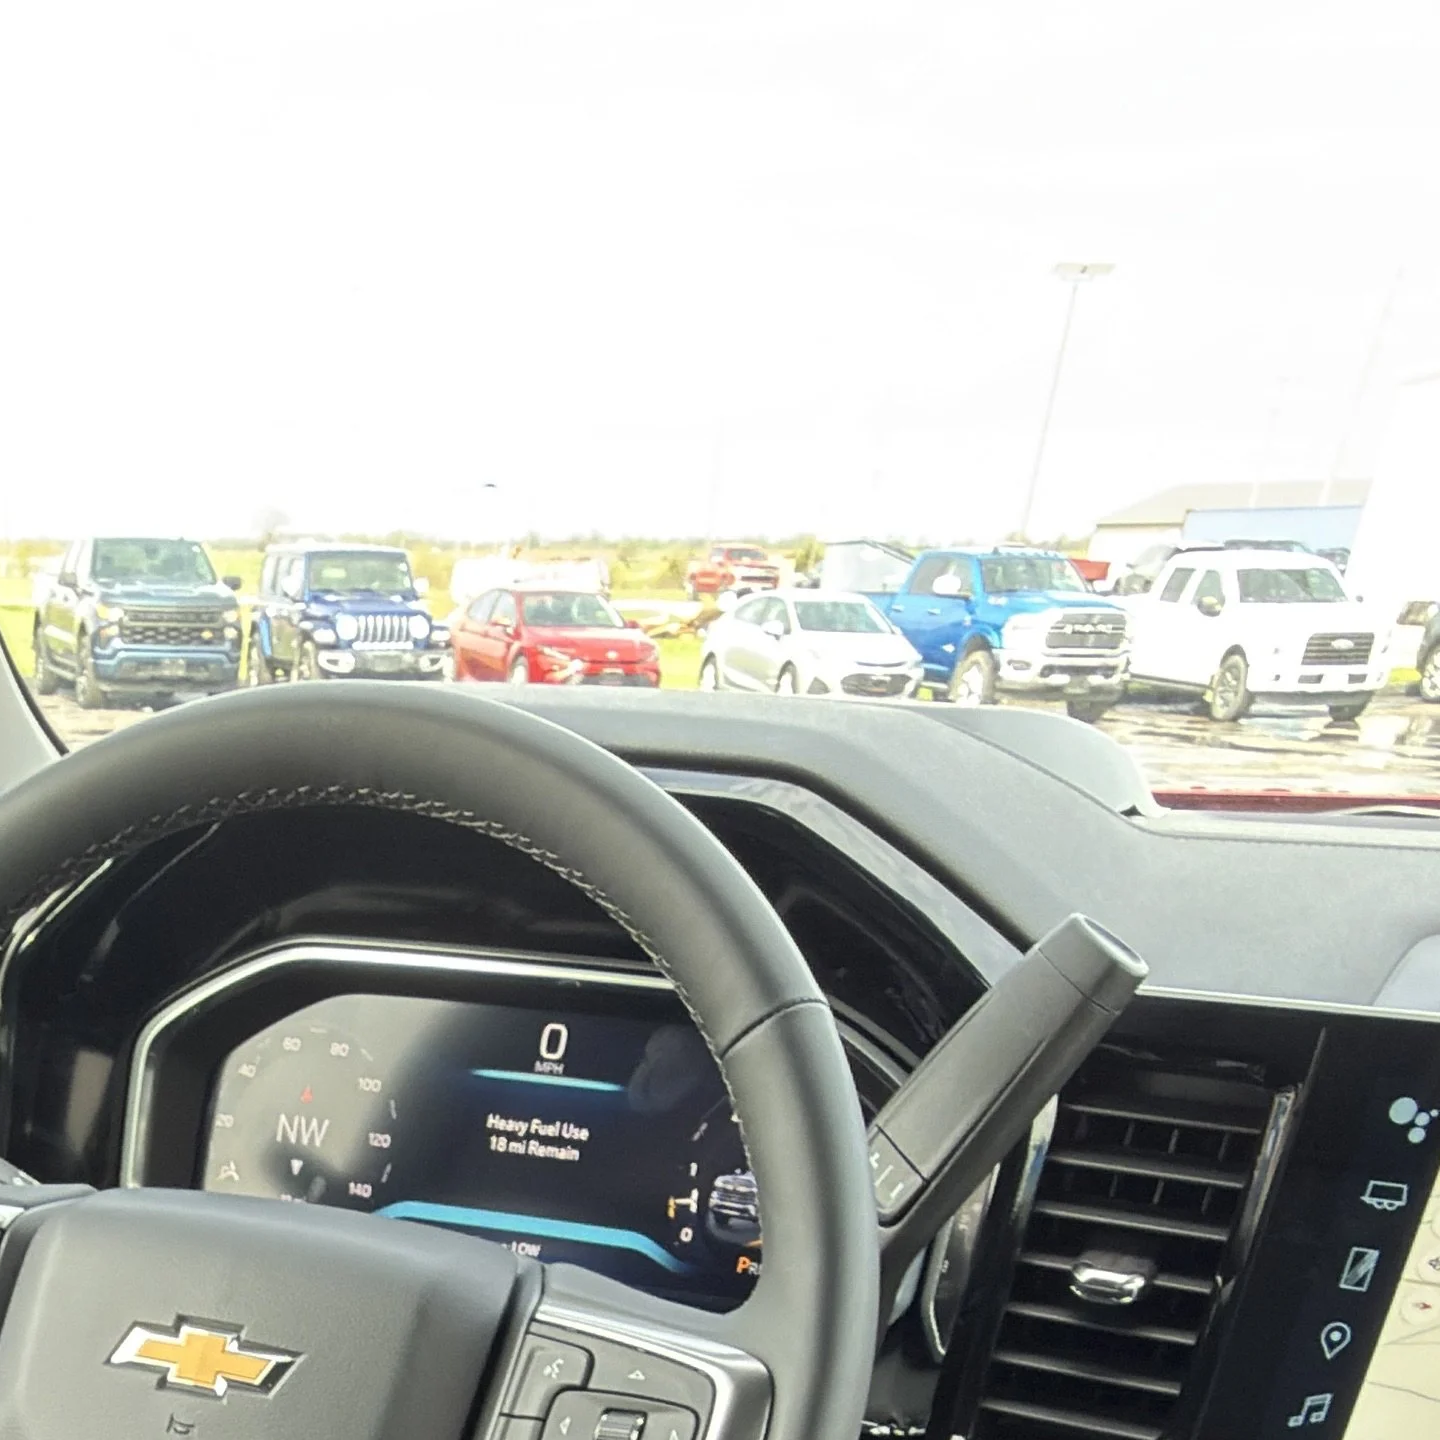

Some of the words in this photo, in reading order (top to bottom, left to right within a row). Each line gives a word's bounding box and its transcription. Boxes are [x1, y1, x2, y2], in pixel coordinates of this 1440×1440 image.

[539, 1022, 569, 1061] 0
[534, 1060, 564, 1075] MPH
[358, 1077, 382, 1092] 100
[275, 1112, 330, 1147] NW
[368, 1131, 392, 1149] 120
[486, 1112, 527, 1137] Heavy
[529, 1117, 561, 1138] Fuel
[562, 1120, 590, 1142] Use
[489, 1134, 508, 1153] 18
[508, 1138, 527, 1156] mi
[527, 1140, 581, 1162] Remain
